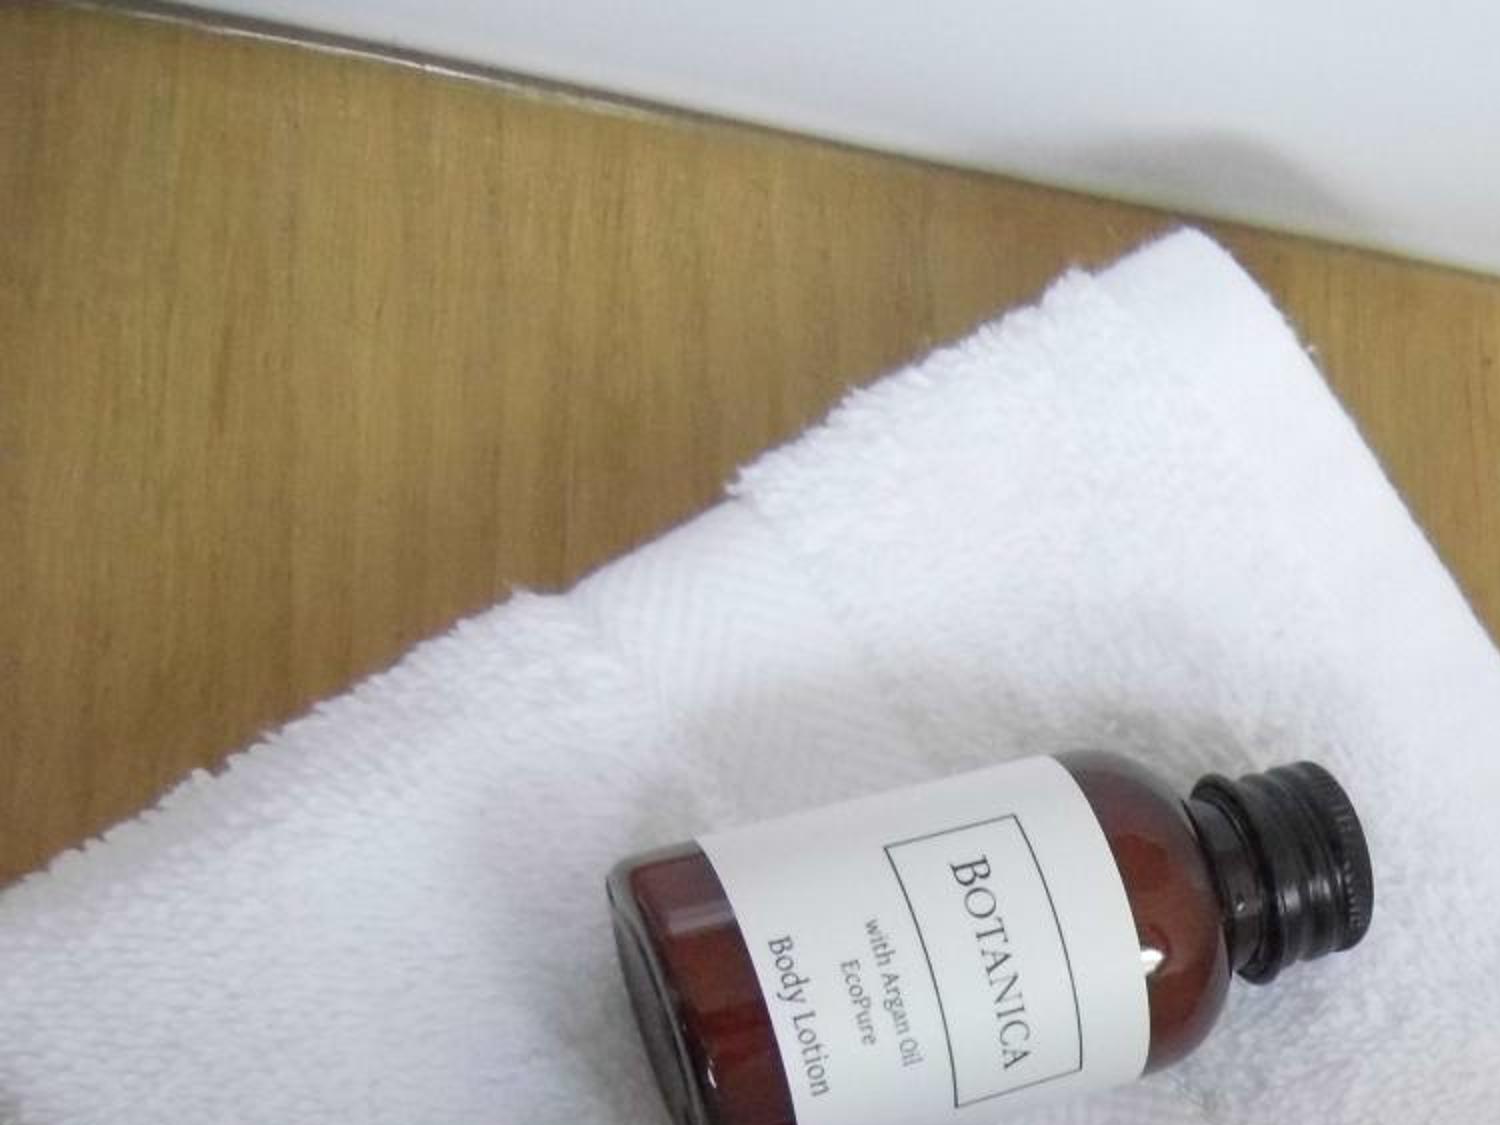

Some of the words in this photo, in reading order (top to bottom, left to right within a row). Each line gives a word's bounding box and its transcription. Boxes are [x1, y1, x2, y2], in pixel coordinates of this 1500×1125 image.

[767, 934, 812, 1004] Body
[792, 1009, 831, 1097] Lotion
[840, 959, 876, 1047] EcoPure
[865, 918, 893, 968] with
[881, 970, 911, 1036] Argan
[899, 1038, 924, 1067] Oil
[950, 854, 1032, 1071] BOTANICA
